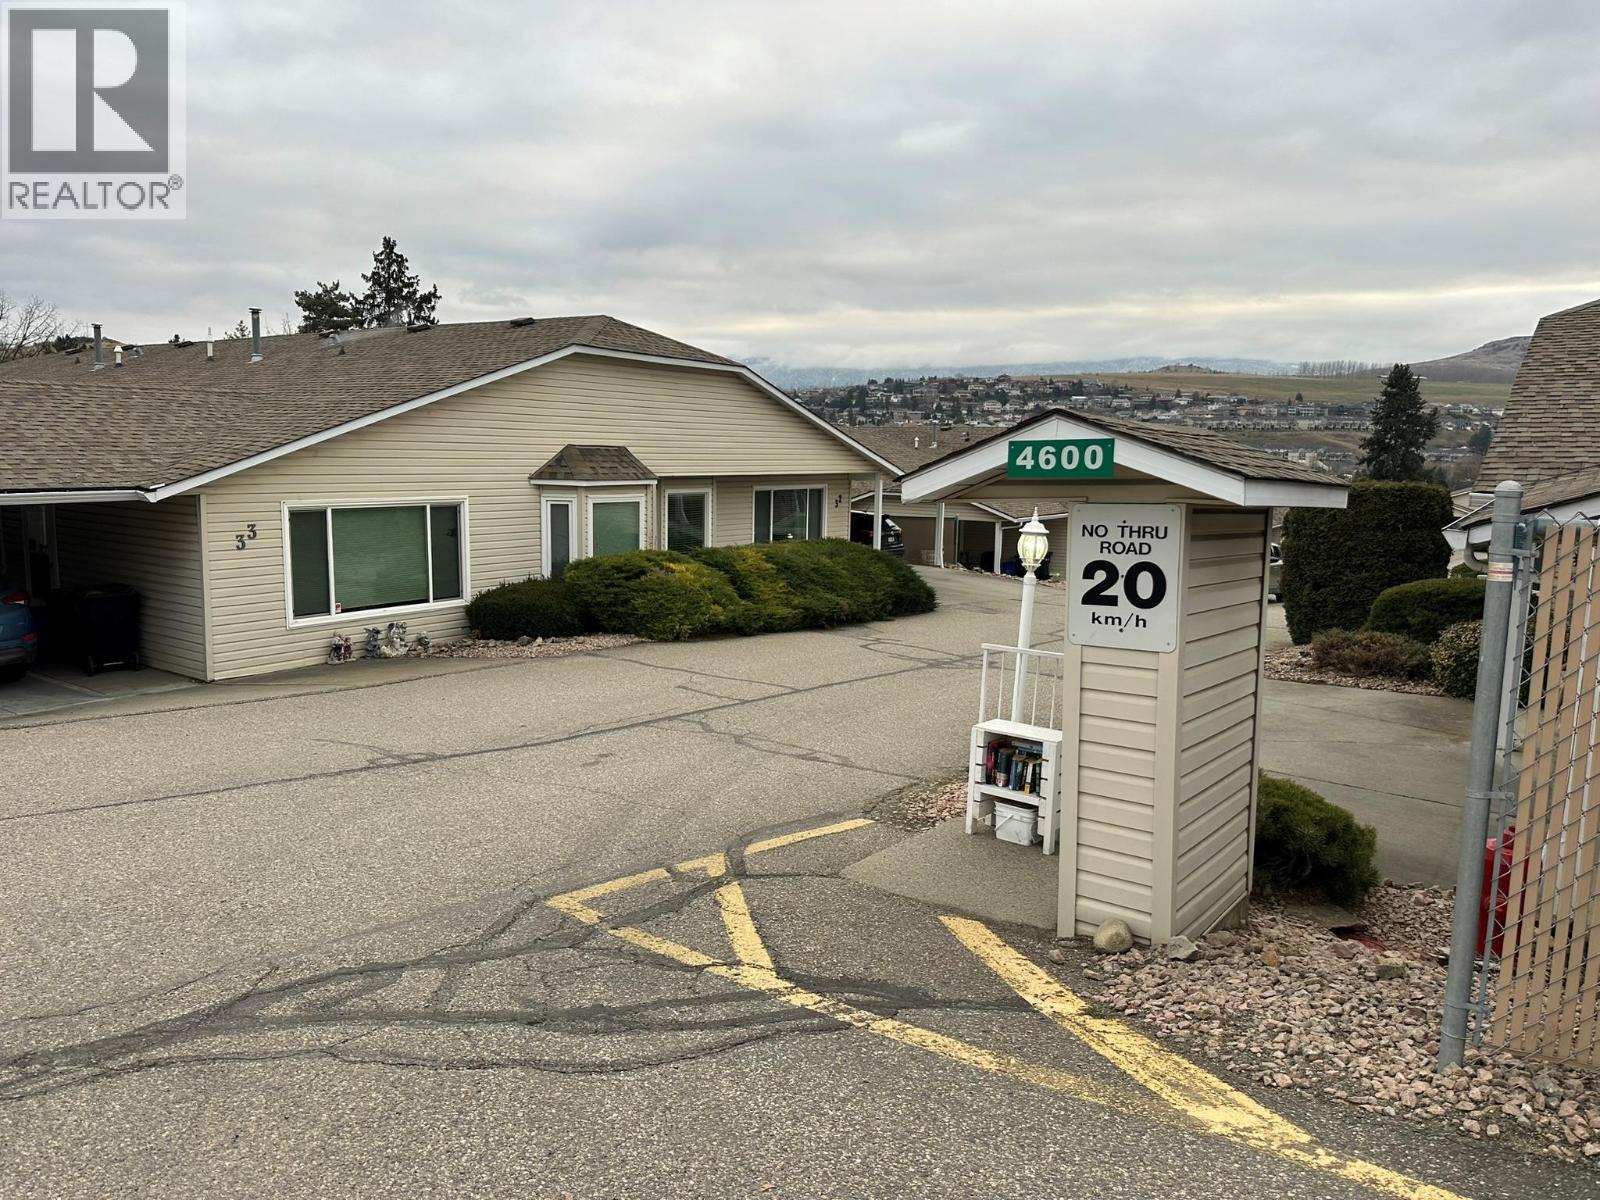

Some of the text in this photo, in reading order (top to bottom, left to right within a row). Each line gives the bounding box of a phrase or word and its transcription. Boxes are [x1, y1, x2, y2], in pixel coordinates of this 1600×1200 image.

[1015, 444, 1104, 470] 4600
[235, 523, 257, 550] 33
[1081, 524, 1168, 539] NO THRU
[1099, 541, 1152, 555] ROAD
[1080, 559, 1167, 609] 20
[1091, 612, 1147, 628] km/h
